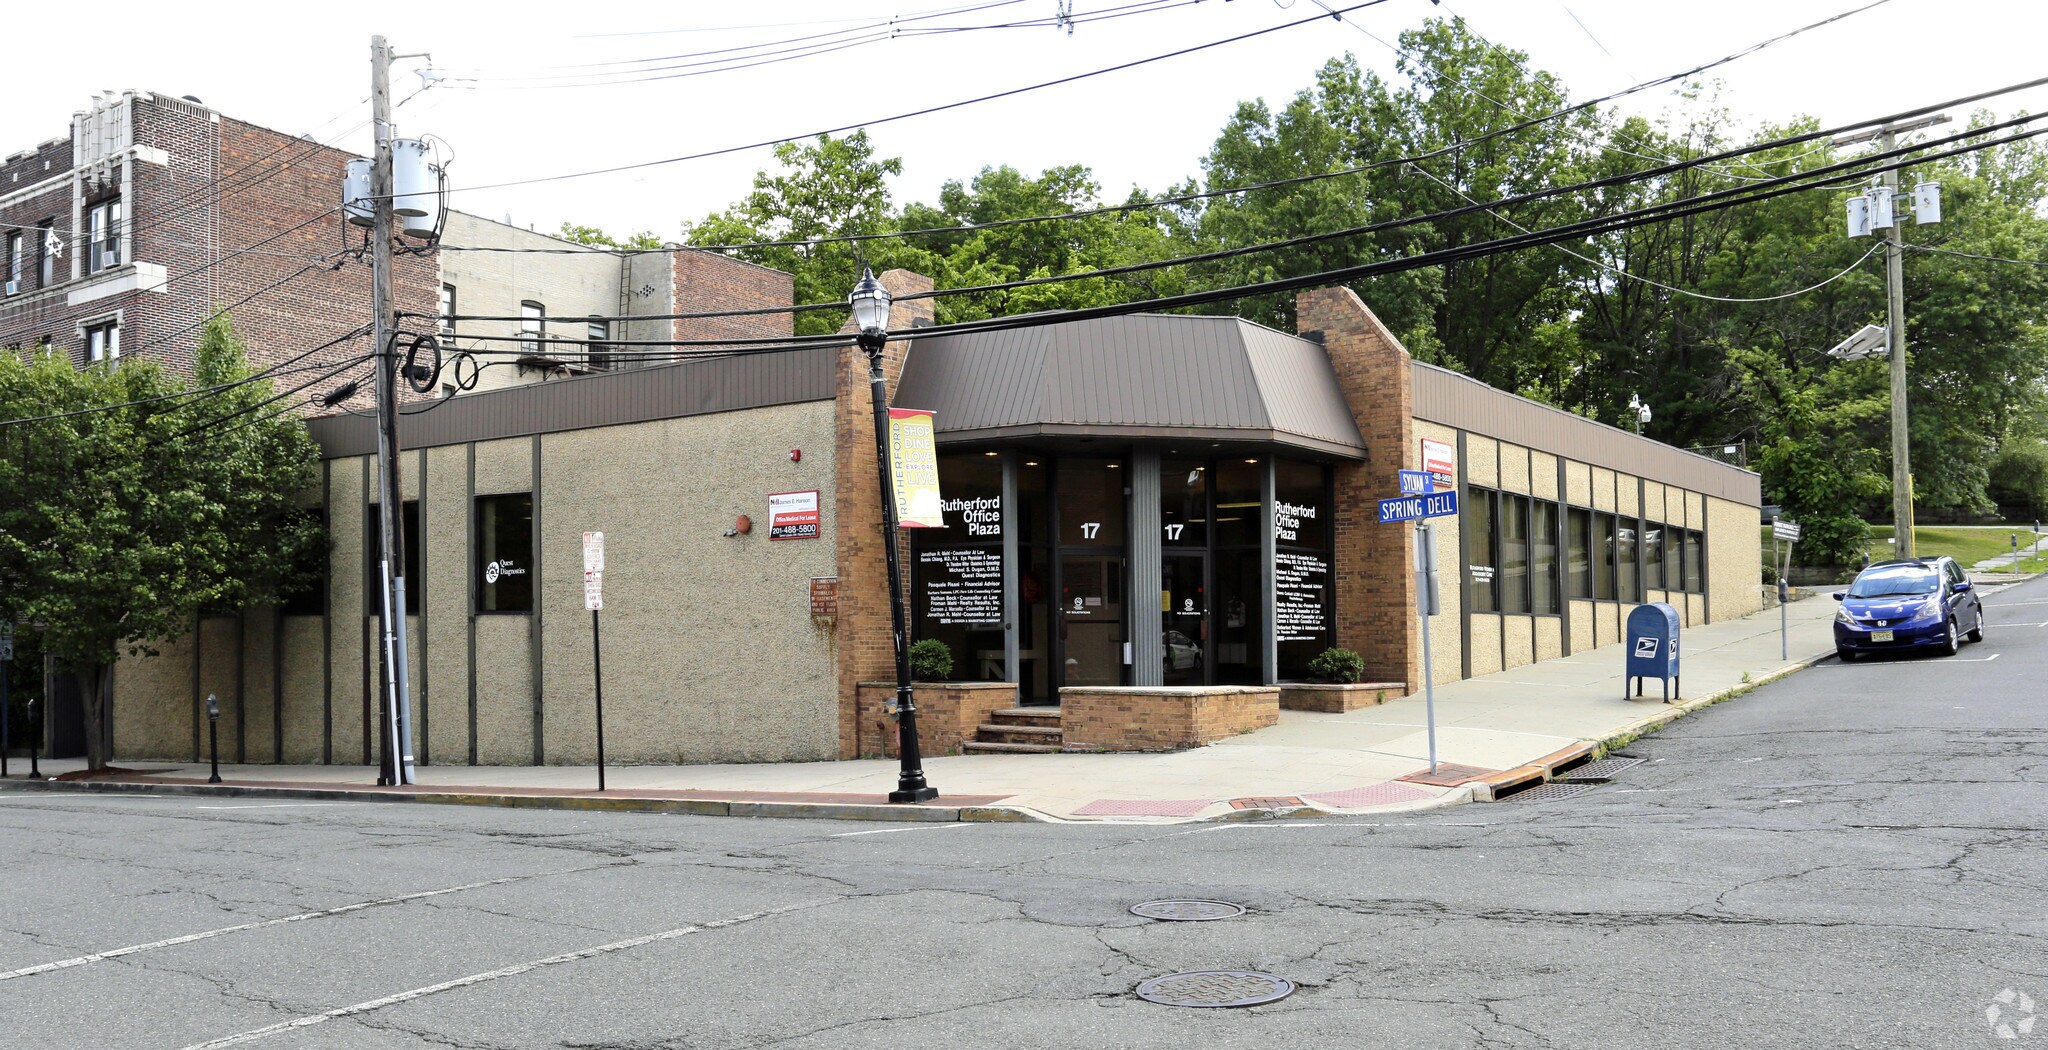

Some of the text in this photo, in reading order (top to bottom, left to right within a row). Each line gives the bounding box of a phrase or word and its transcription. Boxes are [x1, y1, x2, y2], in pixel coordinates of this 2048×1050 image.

[903, 425, 931, 436] SHOP
[904, 437, 931, 450] DINE
[905, 451, 933, 463] LOVE
[893, 422, 908, 515] RUTHERFORD
[907, 472, 936, 486] LIVE
[1402, 473, 1424, 492] SYLVAN
[1424, 475, 1429, 484] ST
[941, 496, 1000, 511] Rutherford
[1275, 500, 1315, 518] Rutherford
[1382, 495, 1453, 520] SPRING DELL
[963, 509, 1000, 523] Office
[1276, 513, 1300, 528] Office
[773, 524, 816, 534] 201-488-5800
[969, 522, 1000, 535] Plaza
[1080, 522, 1100, 539] 17
[1164, 524, 1184, 540] 17
[1276, 526, 1296, 540] Plaza
[500, 559, 513, 567] Quest
[500, 567, 525, 576] Diagnostics
